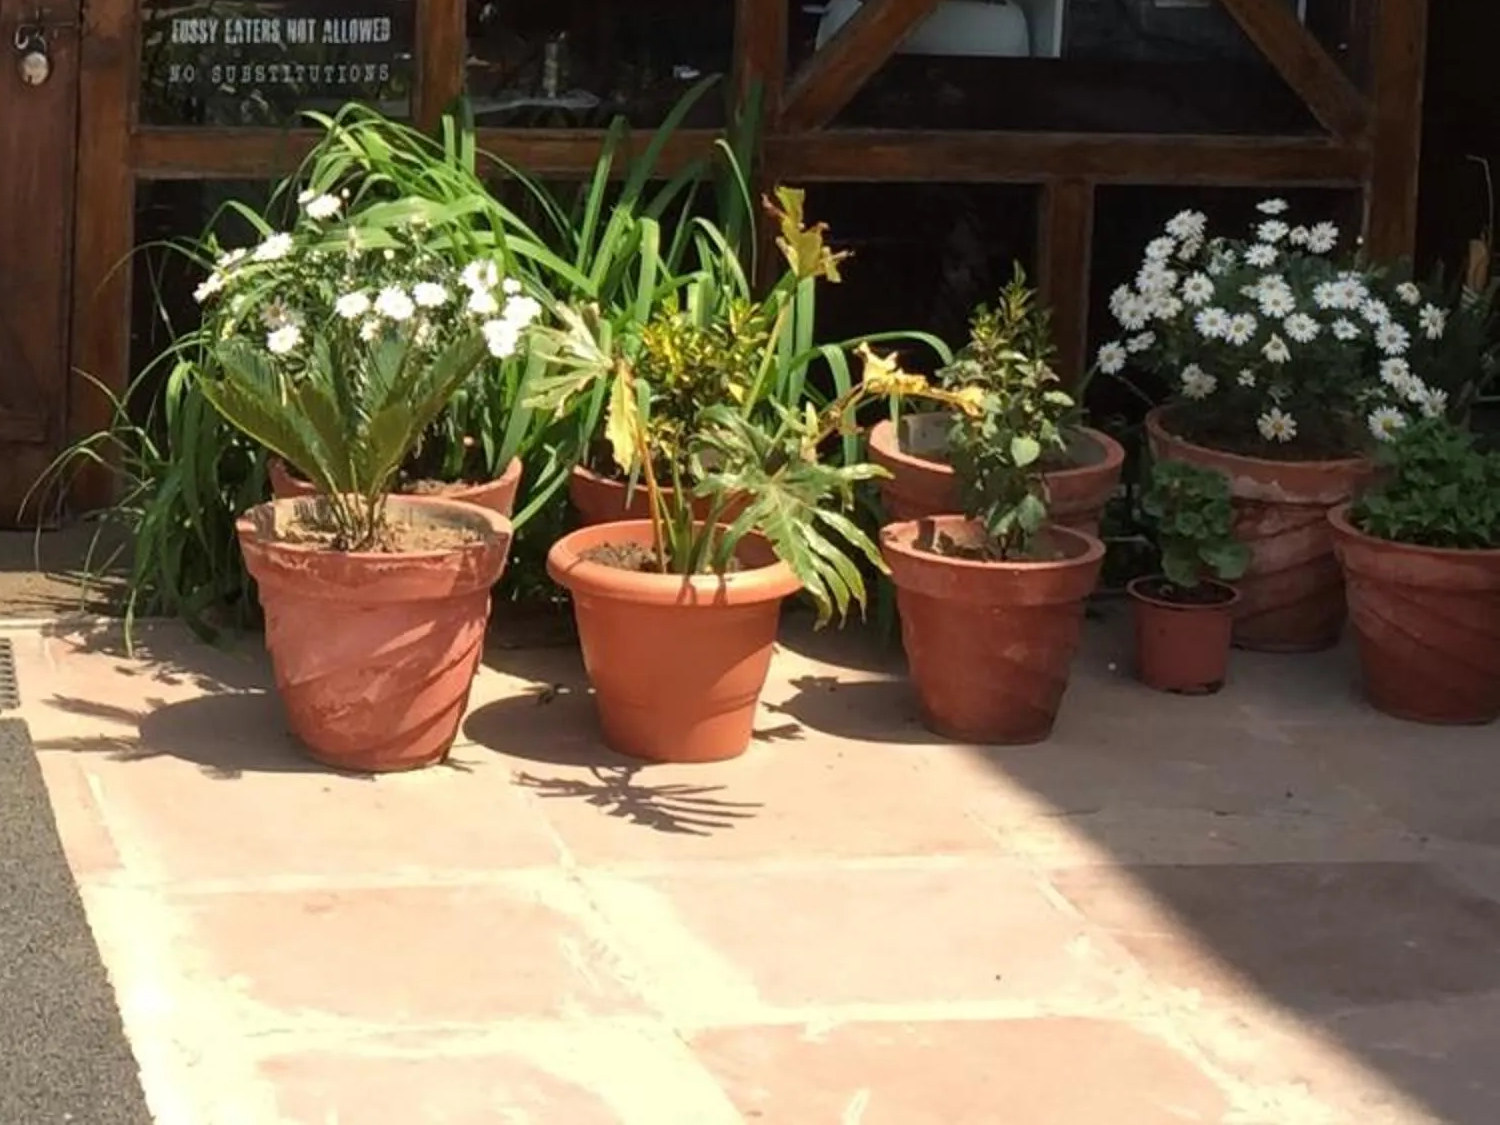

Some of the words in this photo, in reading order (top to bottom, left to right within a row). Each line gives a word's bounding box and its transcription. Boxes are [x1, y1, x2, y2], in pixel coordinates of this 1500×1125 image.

[171, 18, 218, 44] FUSSY
[224, 18, 281, 44] EATERS
[287, 18, 317, 44] NOT
[322, 17, 391, 44] ALLOWED
[169, 66, 196, 83] NO
[211, 64, 390, 83] SUBSTITUTIONS
